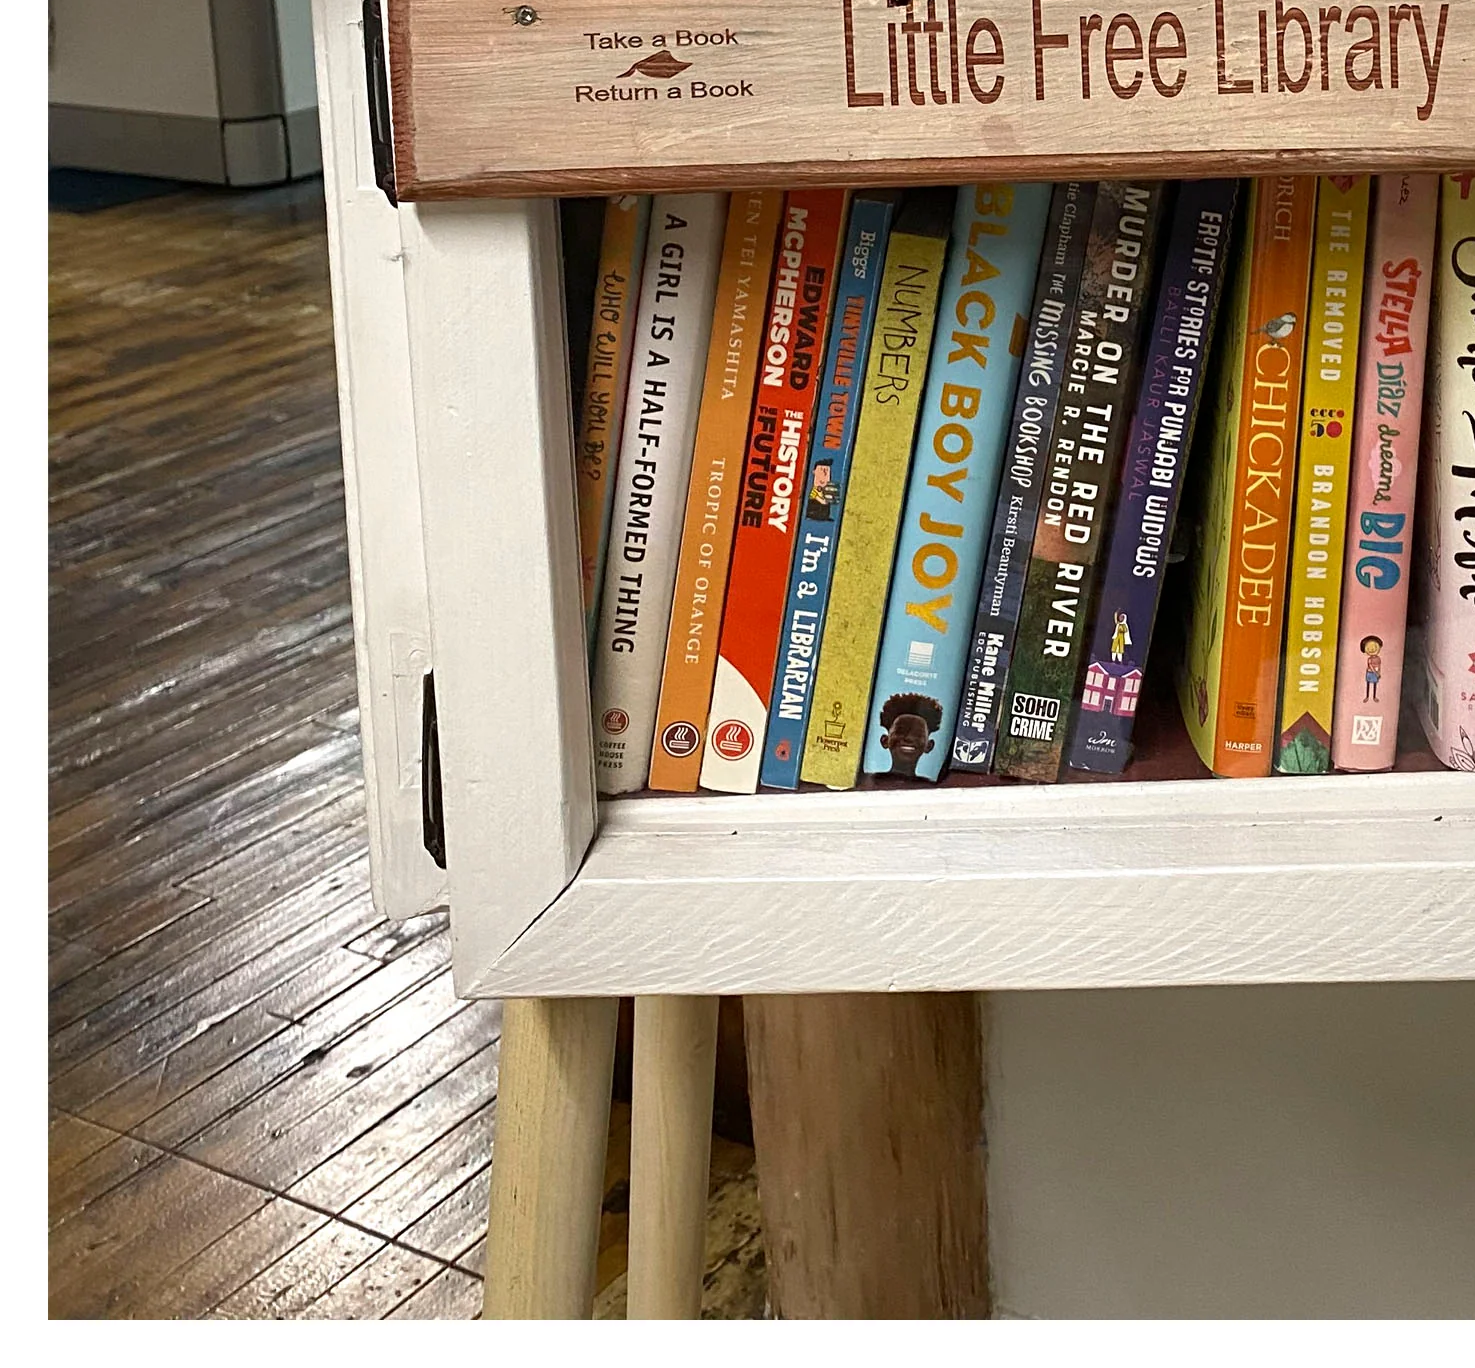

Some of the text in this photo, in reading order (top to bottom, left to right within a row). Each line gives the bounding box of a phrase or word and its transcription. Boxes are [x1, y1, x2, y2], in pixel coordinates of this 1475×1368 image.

[583, 28, 740, 51] Take a Book
[574, 79, 755, 103] Return a Book
[739, 234, 758, 267] TEI
[851, 230, 877, 280] Biggs
[1054, 203, 1077, 265] Clapham
[1328, 209, 1353, 254] THE
[599, 268, 626, 324] WHO
[762, 205, 809, 388] MCPHERSON
[789, 264, 826, 392] EDWARD
[1049, 272, 1067, 295] THE
[1319, 269, 1349, 382] REMOVED
[1375, 256, 1422, 357] STELLA
[591, 331, 617, 382] WILL
[721, 274, 751, 401] YAMASHITA
[823, 294, 866, 451] TINYVILLE TOWN
[873, 263, 930, 407] NUMBERS
[611, 213, 689, 655] A GIRL IS A HALF-FORMED THING
[904, 182, 1015, 636] BLACK BOY JOY
[1010, 396, 1048, 489] BOOKSHOP
[1043, 310, 1098, 527] MARCIE R. RENDON
[1043, 186, 1151, 659] MURDER ON THE RED RIVER
[1127, 285, 1182, 501] BALLI KAUR JASWAL
[1132, 209, 1223, 579] EROTIC STORIES FOR PUNJABI WIDOWS
[742, 414, 777, 529] FUTURE
[767, 409, 804, 534] THE HISTORY
[1236, 343, 1292, 628] CHICKADEE
[1373, 422, 1401, 506] dreams
[684, 456, 726, 665] TROPIC OF ORANGE
[1004, 495, 1024, 535] Kirsti
[1305, 463, 1335, 580] BRANDON
[1355, 511, 1407, 591] BIG
[777, 532, 830, 722] I'm a LIBRARIAN
[989, 538, 1016, 618] Beautyman
[962, 631, 986, 727] EDC PUBLISHING
[971, 633, 1005, 733] Kane Miller
[1298, 596, 1325, 693] HOBSON
[1010, 717, 1055, 742] CRIME
[1013, 695, 1059, 719] SOHO
[1224, 740, 1262, 752] HARPER
